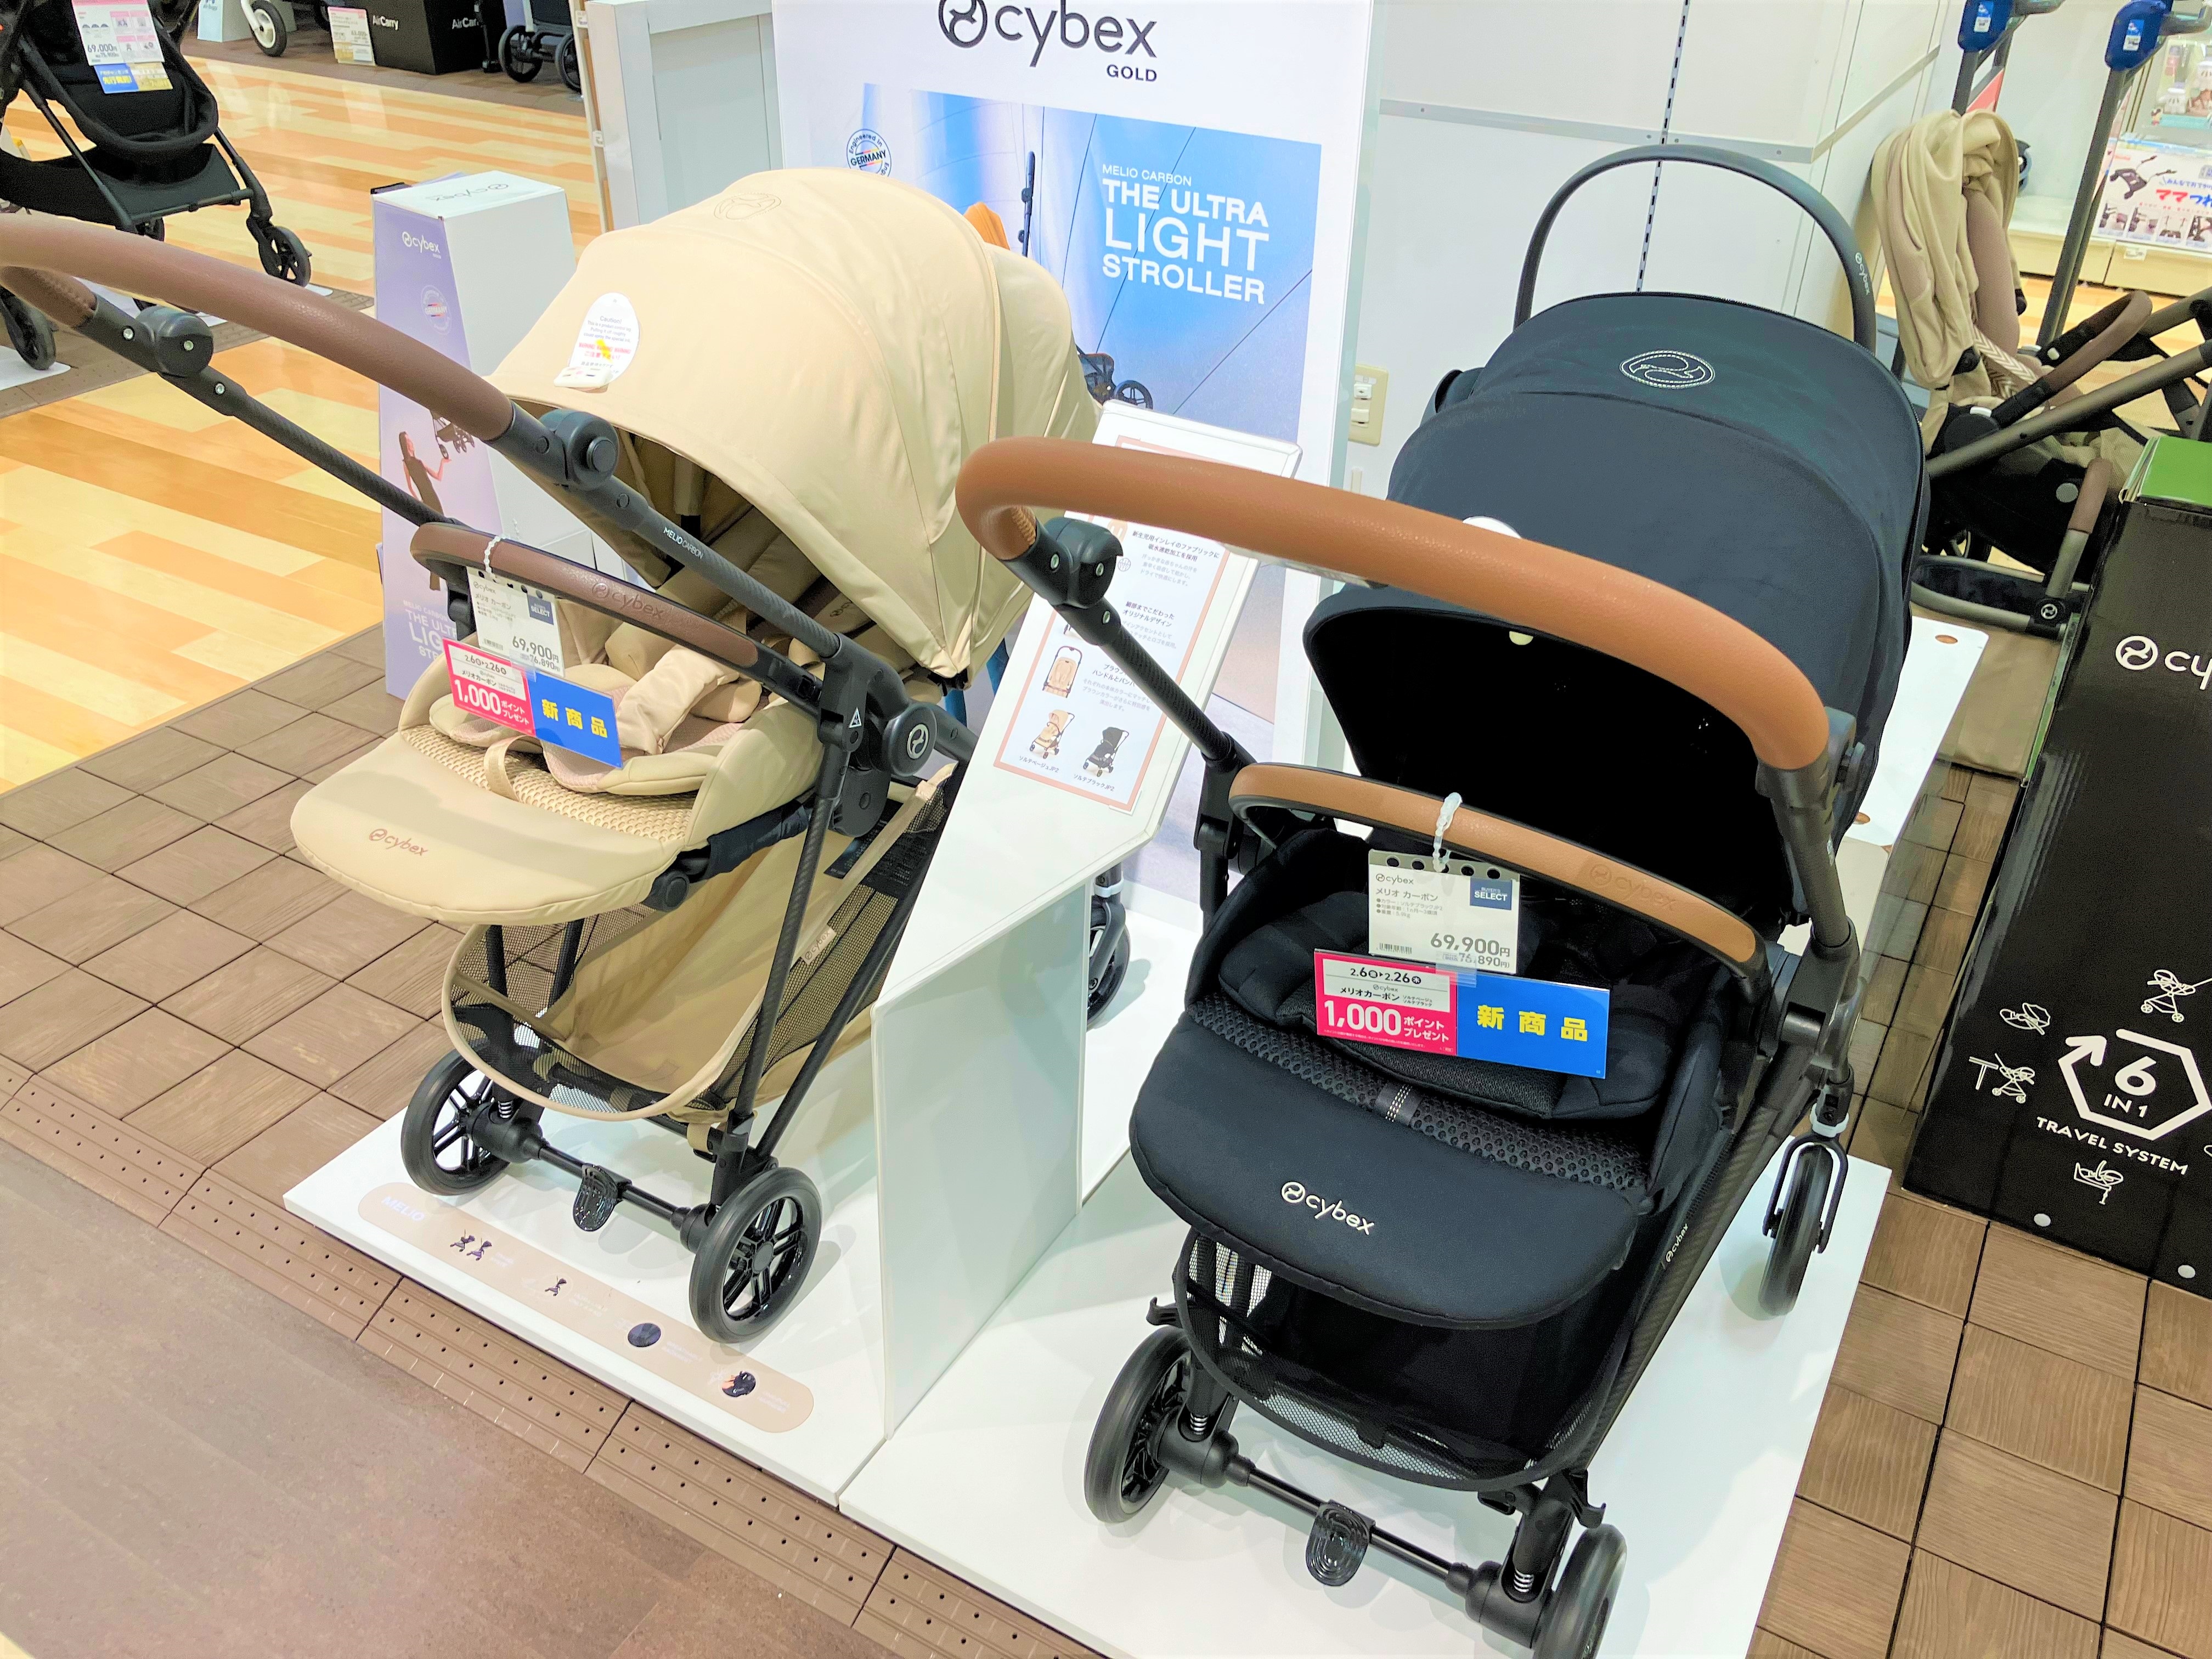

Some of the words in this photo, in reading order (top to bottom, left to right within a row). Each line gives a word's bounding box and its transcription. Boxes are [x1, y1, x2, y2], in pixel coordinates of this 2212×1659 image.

[373, 15, 399, 30] AirCarry
[995, 0, 1156, 67] cybex
[1107, 64, 1157, 82] GOLD
[849, 134, 876, 154] Engineered
[850, 150, 885, 166] GERMANY
[1102, 164, 1138, 178] MELIO
[1141, 170, 1192, 187] CARBON
[1102, 178, 1159, 210] THE
[1171, 189, 1269, 228] ULTRA
[413, 235, 440, 253] cybex
[1105, 208, 1269, 271] LIGHT
[1102, 253, 1264, 304] STROLLER
[1859, 263, 1870, 295] cybex
[600, 315, 622, 324] Caution!
[663, 527, 682, 545] MELIO
[682, 540, 703, 560] CARBON
[491, 599, 511, 610] カーボン
[531, 606, 550, 617] SELECT
[612, 592, 663, 619] cybex
[405, 609, 428, 627] THE
[432, 619, 458, 637] ULTR
[512, 636, 558, 663] 69,900円
[462, 670, 497, 686] メリオカーボン
[454, 679, 501, 715] 1,000
[501, 700, 525, 714] ポイント
[502, 709, 529, 725] プレゼント
[541, 698, 608, 738] 新商品
[384, 836, 428, 856] cybex
[1386, 876, 1414, 885] cybex
[1375, 888, 1400, 898] メリオ
[1403, 891, 1438, 901] カーボン
[1474, 891, 1508, 901] SELECT
[1615, 877, 1676, 911] cybex
[811, 930, 830, 952] cybex
[1430, 933, 1510, 957] 69,900円
[1340, 988, 1400, 1001] メリオカーボン
[1324, 1000, 1401, 1036] 1,000
[1404, 1016, 1444, 1030] ポイント
[1477, 1005, 1588, 1041] 新商品
[1404, 1028, 1449, 1043] プレゼント
[2115, 1056, 2157, 1096] 6
[2104, 1093, 2132, 1113] IN
[2138, 1105, 2148, 1118] 1
[2037, 1116, 2107, 1149] TRAVEL
[2113, 1143, 2188, 1175] SYSTEM
[382, 1196, 425, 1222] MELIO
[1306, 1194, 1375, 1235] cybex
[1672, 1223, 1688, 1252] cybex
